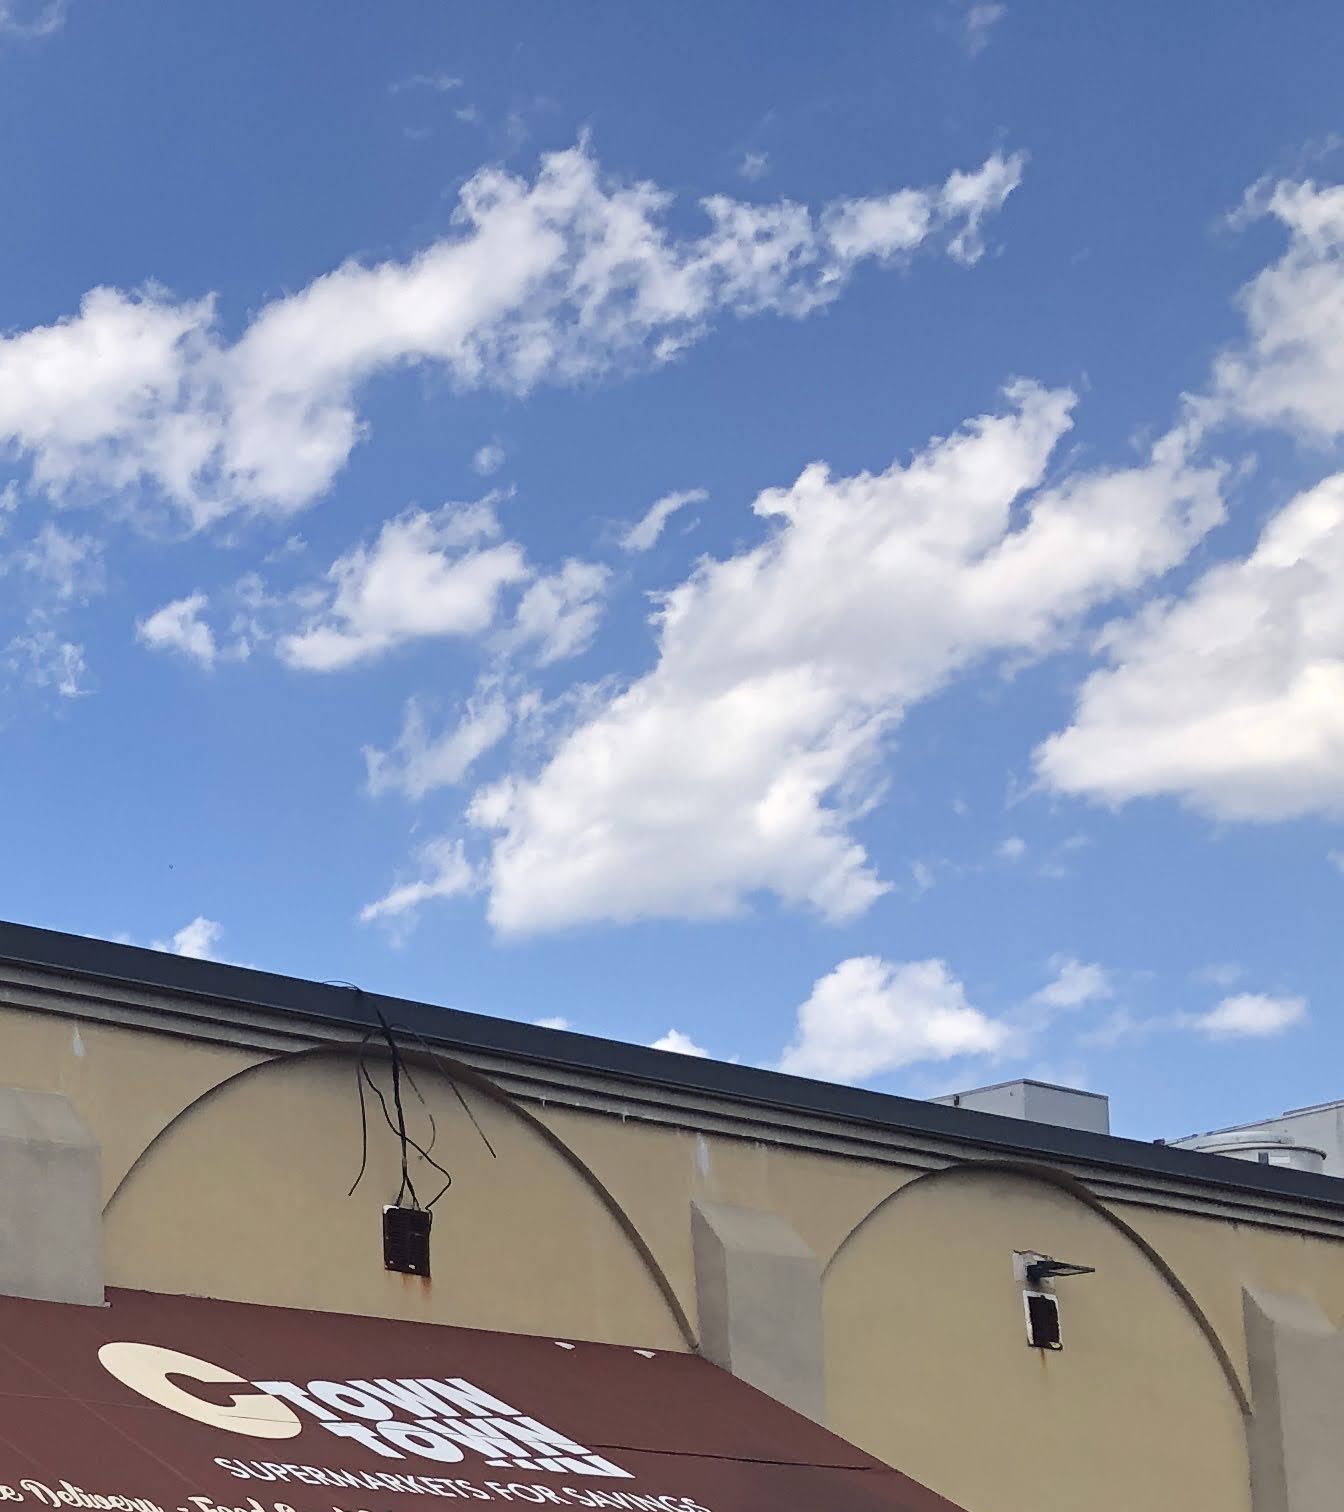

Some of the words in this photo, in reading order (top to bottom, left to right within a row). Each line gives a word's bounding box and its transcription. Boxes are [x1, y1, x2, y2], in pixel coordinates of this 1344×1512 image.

[319, 1417, 593, 1463] TOWN
[214, 1457, 491, 1500] SUPERMARKETS
[484, 1481, 574, 1505] FOR
